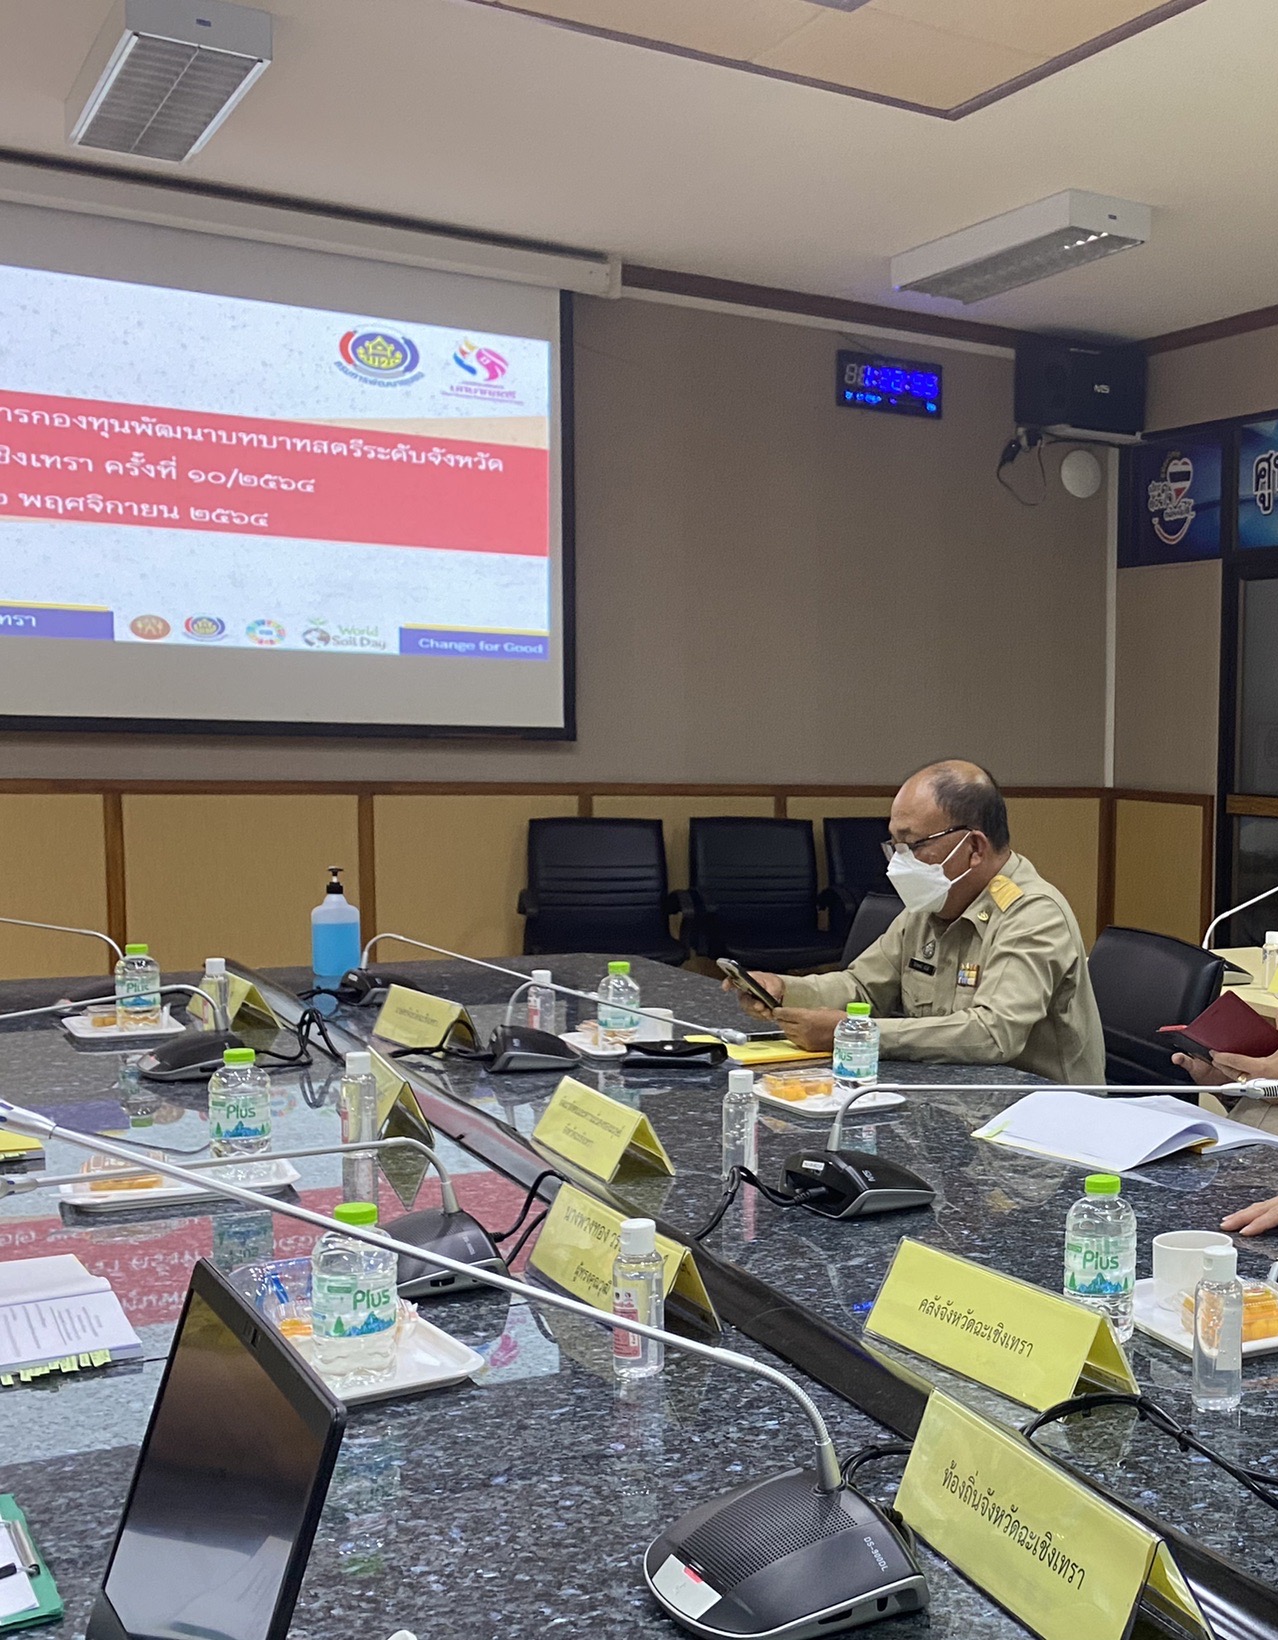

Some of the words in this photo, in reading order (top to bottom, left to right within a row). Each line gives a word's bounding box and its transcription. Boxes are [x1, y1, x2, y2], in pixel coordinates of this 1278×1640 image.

[104, 451, 178, 480] ครั้งที่
[18, 492, 180, 520] พฤศจิกายน
[189, 506, 269, 527] ๒๕๖๔
[337, 624, 379, 637] World
[360, 636, 386, 650] Day
[418, 638, 476, 653] Change
[479, 640, 501, 652] for
[503, 642, 543, 654] Good
[226, 1104, 256, 1119] Plus
[1082, 1250, 1119, 1270] Plus
[353, 1289, 391, 1310] Plus
[918, 1294, 1034, 1358] คลังจังหวัดฉะเชิงเทรา
[942, 1459, 1086, 1591] ท้องถิ่นจังหวัดฉะเชิงเทรา
